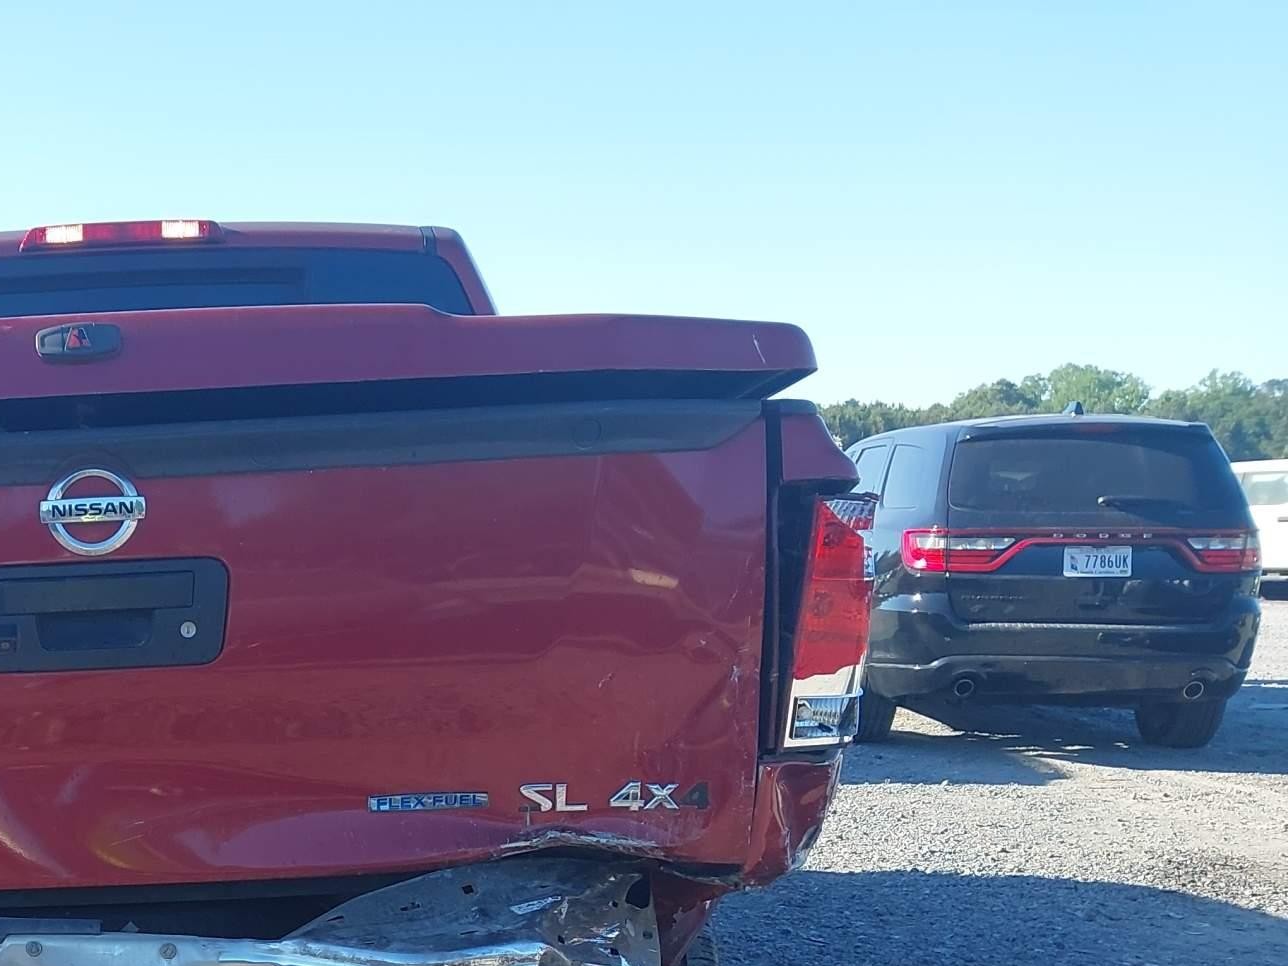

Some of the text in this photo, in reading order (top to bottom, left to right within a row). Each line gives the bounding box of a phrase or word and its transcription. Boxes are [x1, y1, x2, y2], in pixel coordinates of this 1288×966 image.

[51, 501, 135, 518] NISSAN
[1085, 554, 1130, 569] 7786UK
[376, 794, 482, 811] FLEX FUEL
[519, 783, 588, 812] SL
